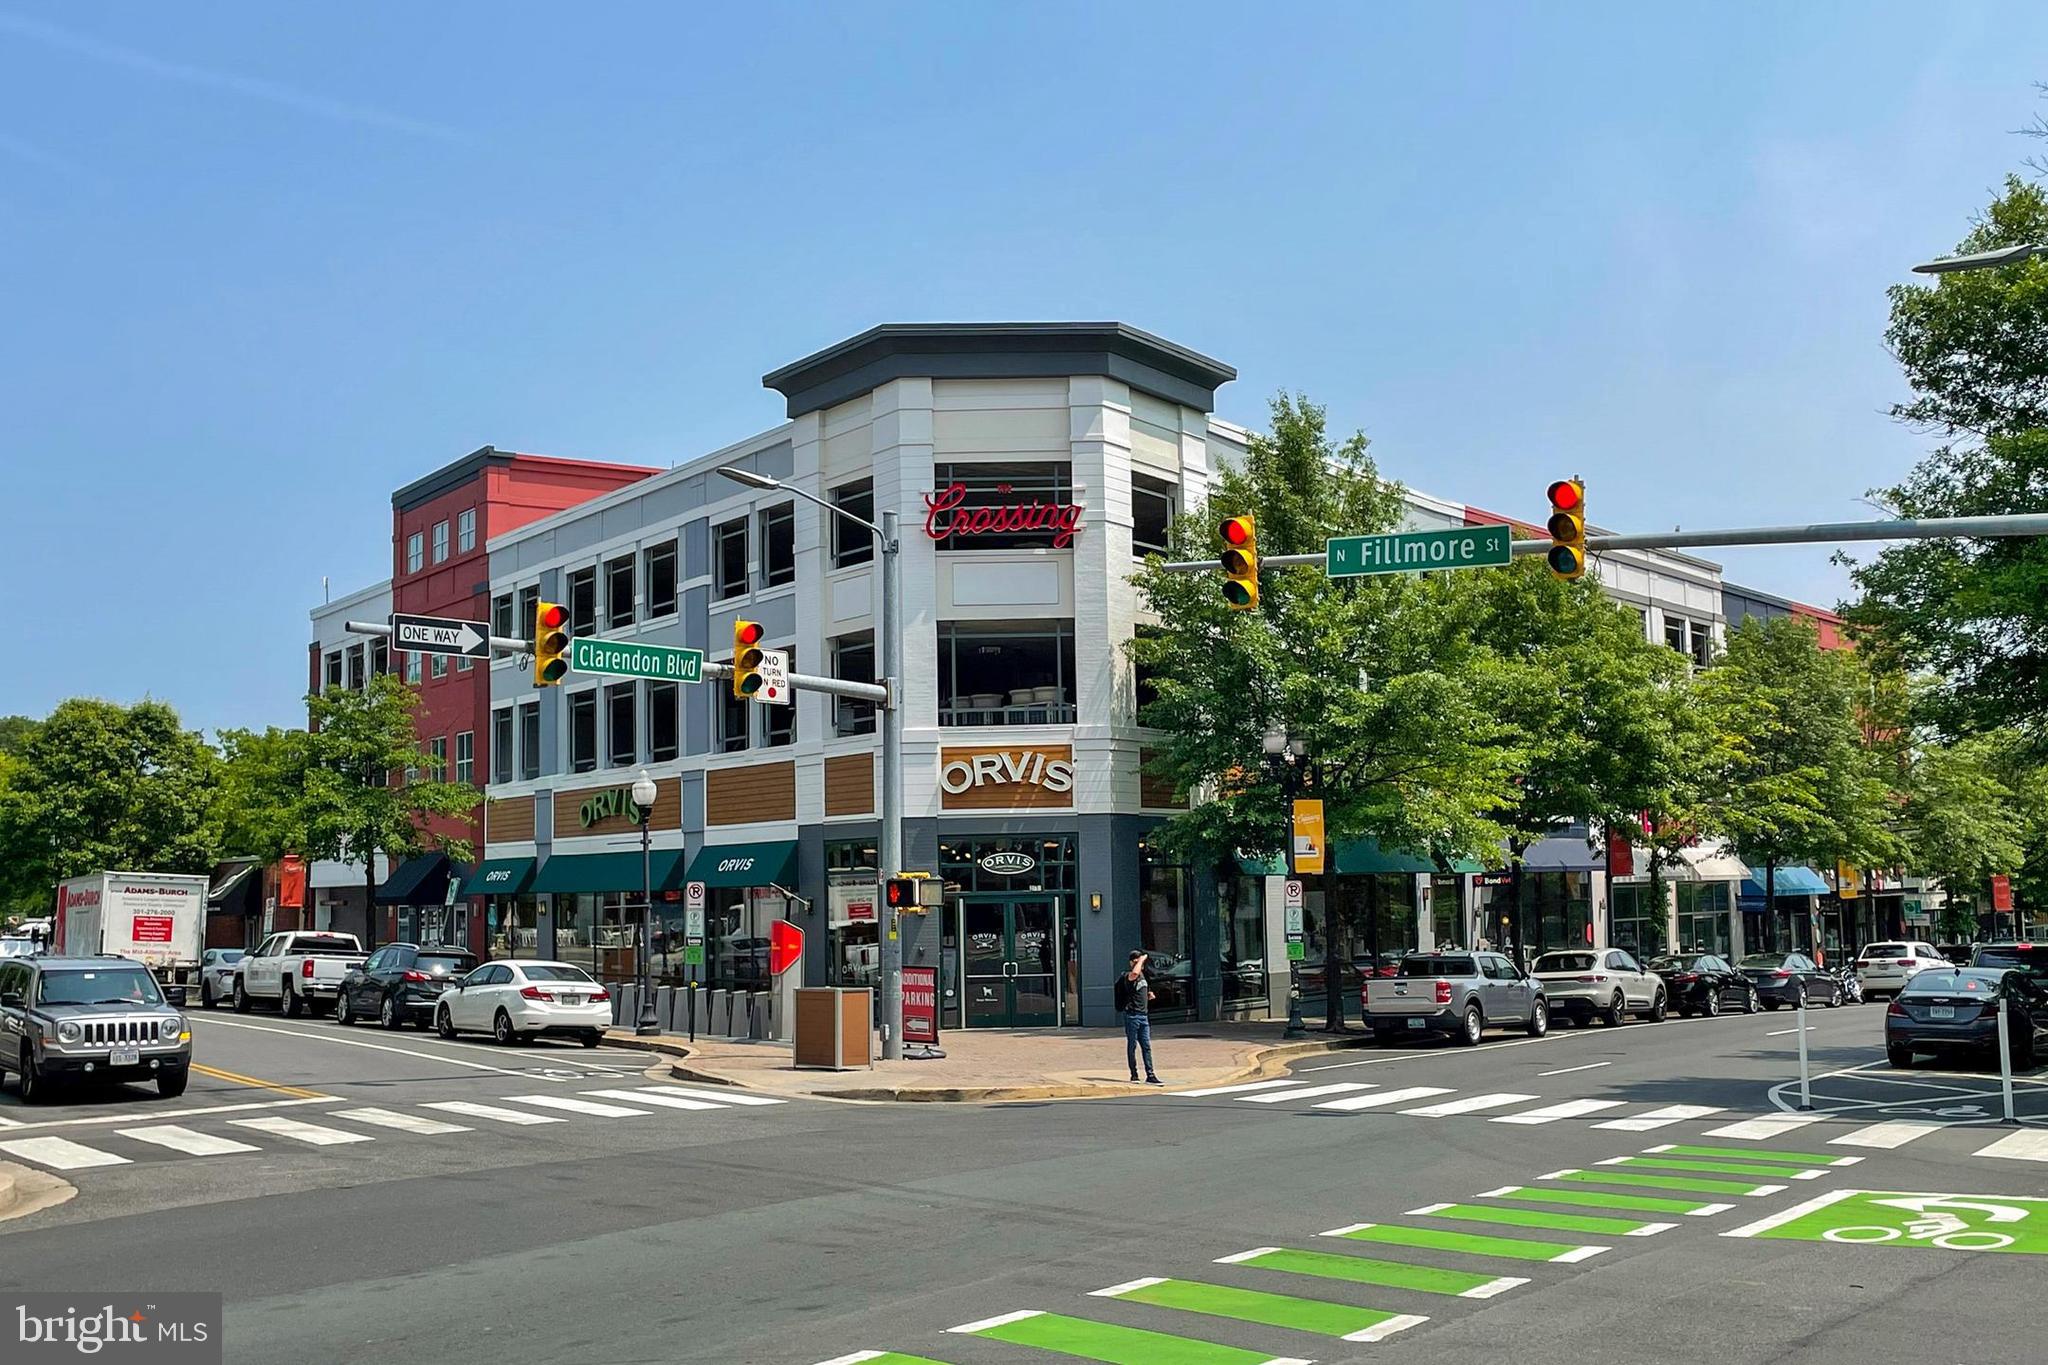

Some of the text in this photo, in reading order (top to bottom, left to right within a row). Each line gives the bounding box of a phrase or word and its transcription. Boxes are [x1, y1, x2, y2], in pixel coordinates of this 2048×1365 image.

[925, 481, 1083, 548] Crossing
[1337, 537, 1500, 566] N Fillmore St
[403, 626, 460, 643] ONE WAY
[580, 645, 697, 677] Clarendon Blvd
[765, 656, 779, 666] NO
[763, 667, 781, 677] TURN
[772, 679, 786, 688] RED
[940, 751, 1075, 794] ORVIS
[579, 788, 640, 829] ORVIS
[718, 858, 754, 871] ORVIS
[984, 855, 1032, 868] ORVIS
[486, 870, 511, 881] ORVIS
[1484, 877, 1501, 885] Bond
[124, 886, 188, 896] ADAMS-BURCH
[1021, 932, 1046, 940] ORVIS
[842, 963, 866, 975] ORVIS
